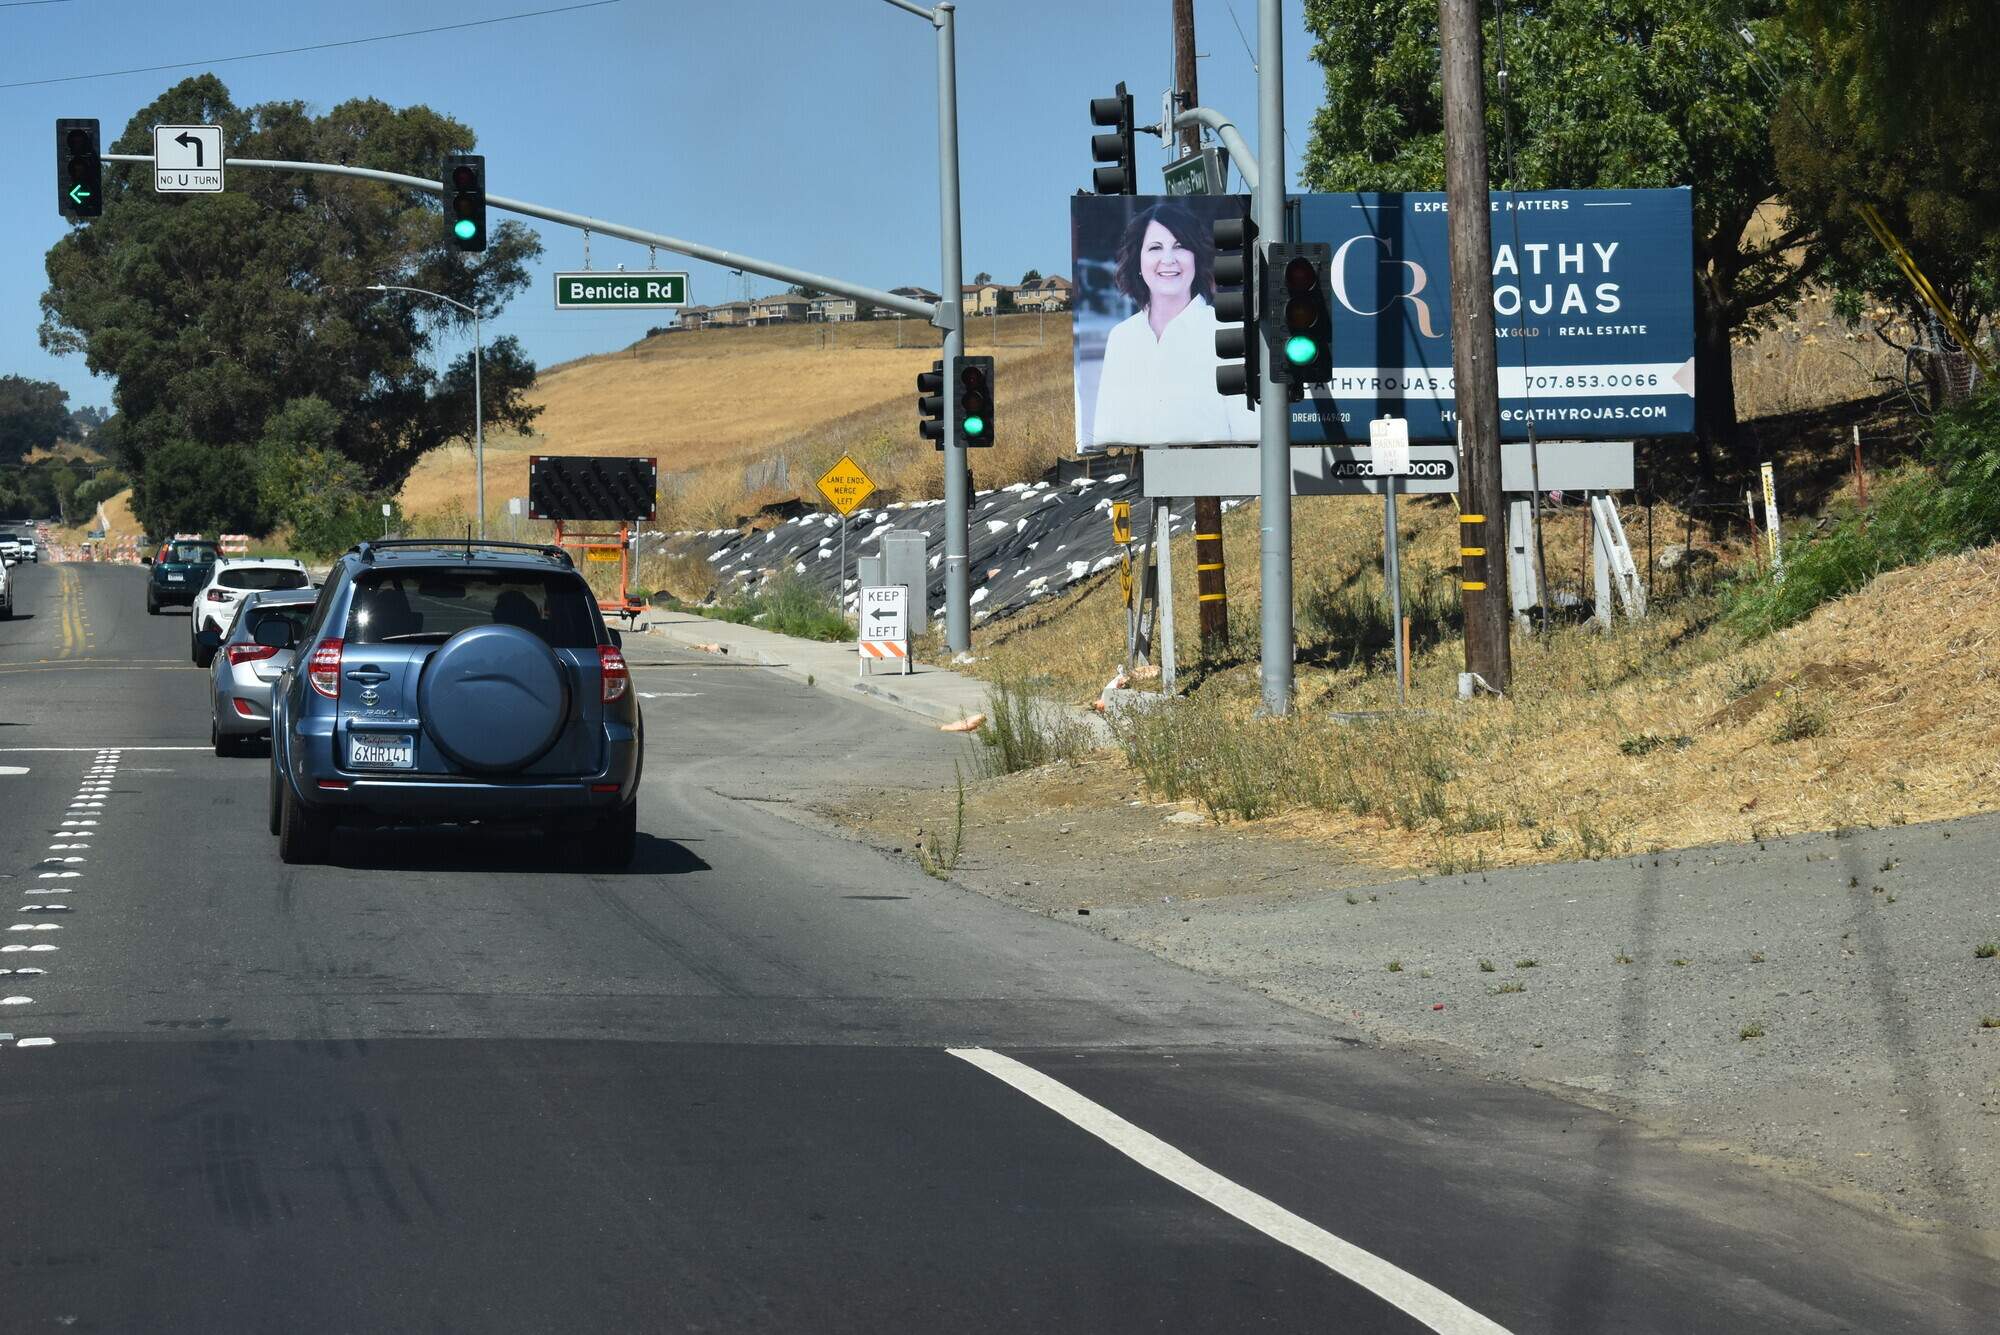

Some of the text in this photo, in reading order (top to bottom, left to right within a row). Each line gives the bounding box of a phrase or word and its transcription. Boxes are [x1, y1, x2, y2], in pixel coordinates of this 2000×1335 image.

[160, 174, 219, 186] NO U TURN
[1506, 200, 1569, 211] MATTERS
[1492, 242, 1619, 276] ATHY
[570, 281, 672, 299] Benicia Rd
[1493, 282, 1621, 316] OJAS
[1559, 327, 1593, 337] REAL
[1597, 325, 1647, 335] ESTATE
[1526, 374, 1658, 389] 707.853.0066
[827, 476, 865, 485] LANE ENDS
[834, 487, 857, 495] MERGE
[837, 497, 853, 505] LEFT
[868, 591, 899, 602] KEEP
[868, 626, 897, 638] LEFT
[354, 746, 407, 762] 6XHR141
